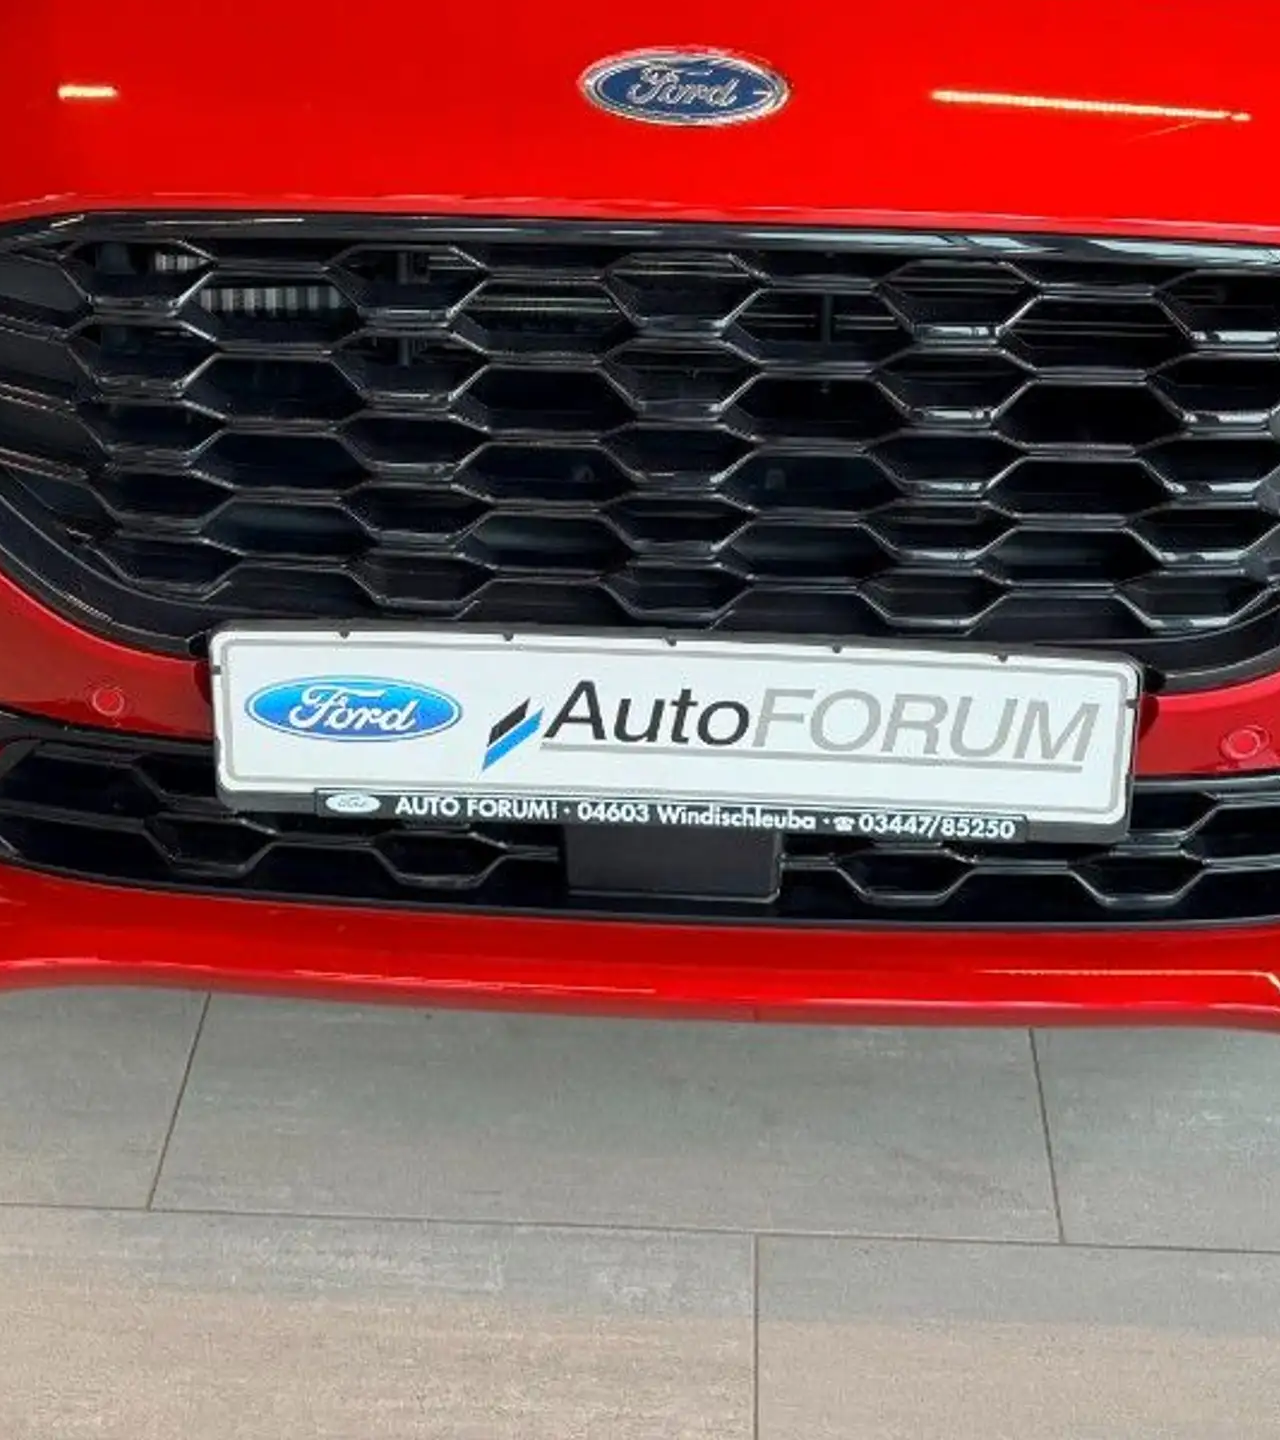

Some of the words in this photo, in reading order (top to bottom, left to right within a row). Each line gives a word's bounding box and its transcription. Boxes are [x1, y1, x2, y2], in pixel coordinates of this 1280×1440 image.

[626, 60, 740, 107] Ford
[288, 684, 421, 732] Ford
[543, 679, 1101, 762] AutoFORUM
[395, 796, 461, 816] AUTO
[577, 801, 650, 823] 04603
[657, 804, 816, 830] Windischleuba
[858, 813, 1016, 840] 03447/85250
